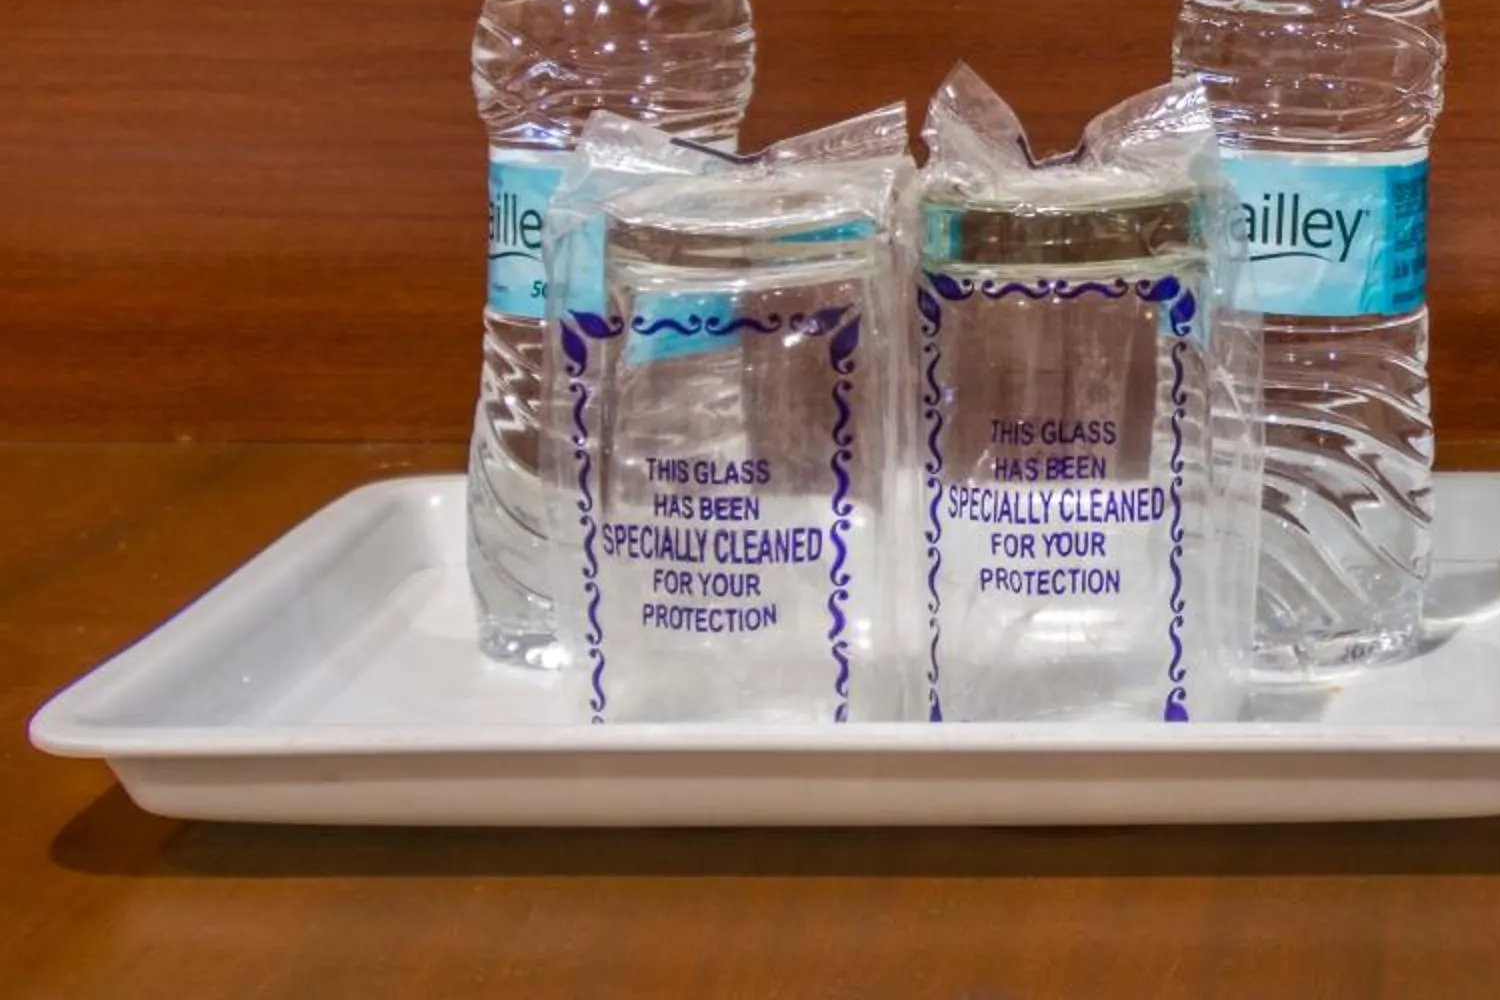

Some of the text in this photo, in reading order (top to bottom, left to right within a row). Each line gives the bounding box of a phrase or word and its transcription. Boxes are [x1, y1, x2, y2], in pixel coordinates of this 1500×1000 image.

[1232, 192, 1364, 263] ailley
[990, 419, 1117, 446] THIS GLASS
[645, 457, 771, 485] THIS GLASS
[993, 455, 1107, 482] HAS BEEN
[653, 493, 760, 521] HAS BEEN
[948, 485, 1165, 525] SPECIALLY CLEANED
[602, 522, 823, 565] SPECIALLY CLEANED
[990, 531, 1107, 559] FOR YOUR
[653, 568, 761, 598] FOR YOUR
[979, 567, 1121, 596] PROTECTION
[642, 602, 777, 633] PROTECTION
